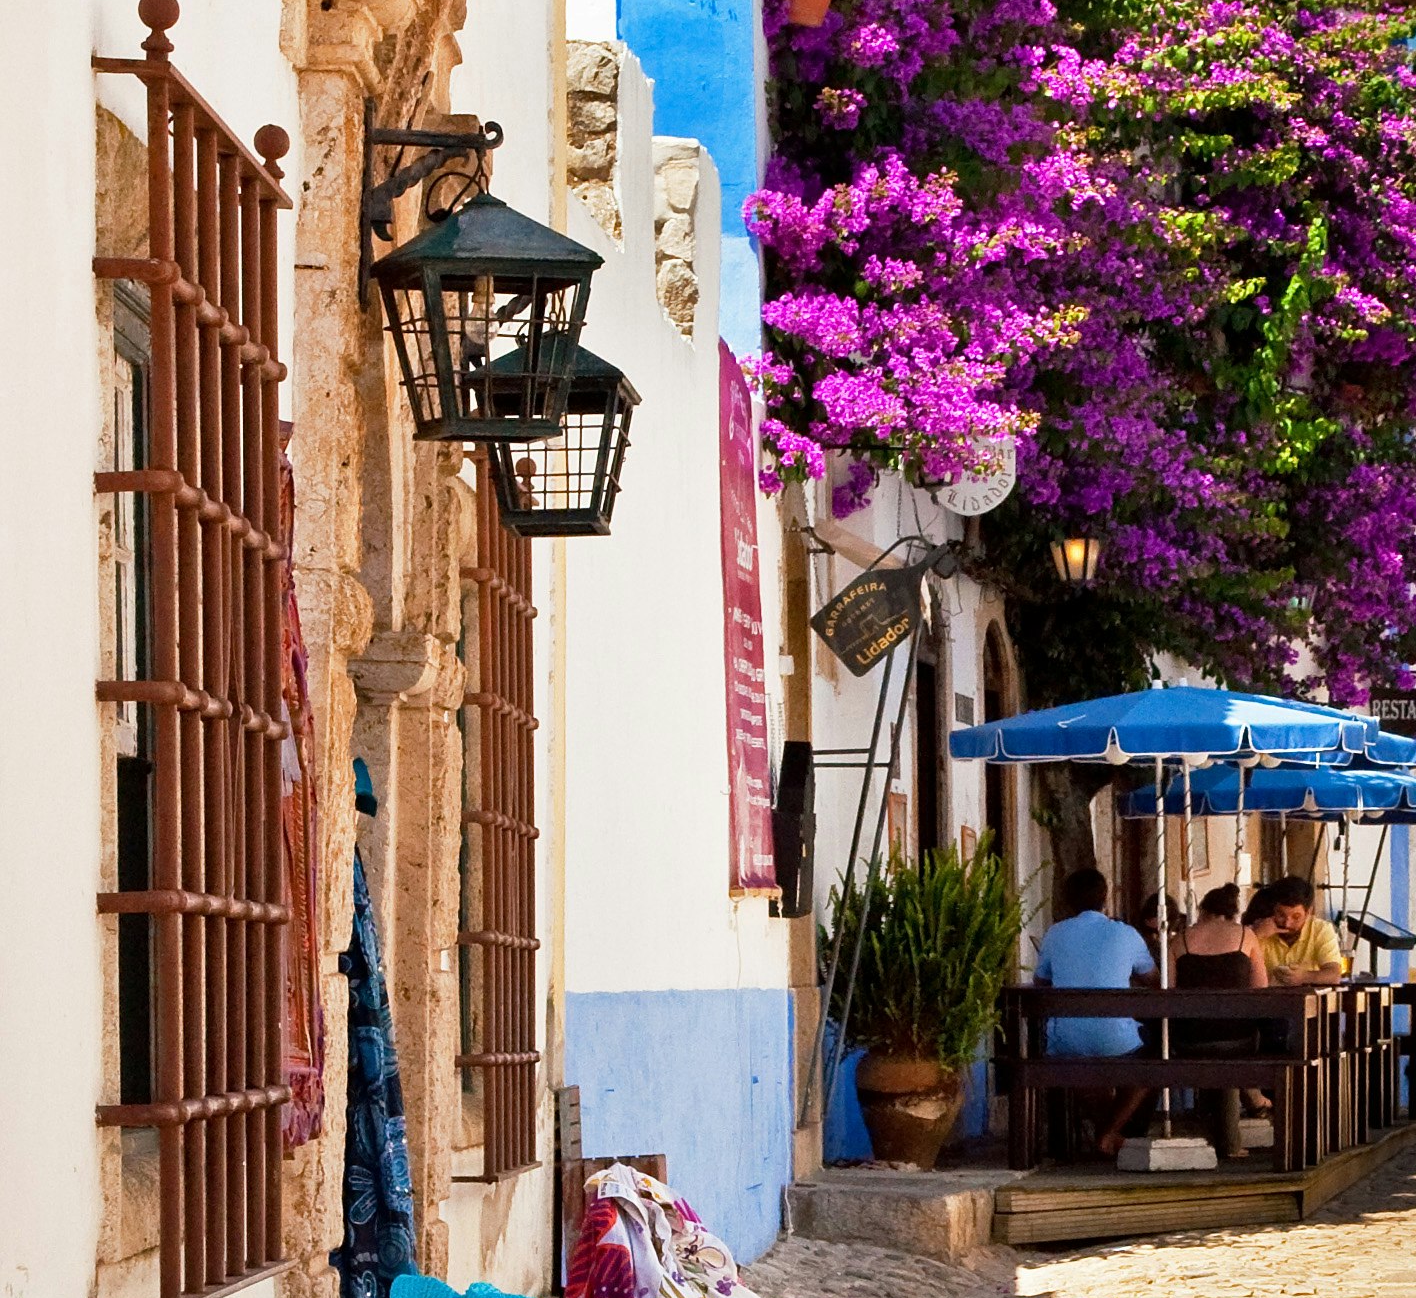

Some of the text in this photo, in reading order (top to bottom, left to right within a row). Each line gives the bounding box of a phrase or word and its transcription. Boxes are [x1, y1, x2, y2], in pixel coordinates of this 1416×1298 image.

[947, 472, 1012, 512] Lidador
[825, 582, 887, 636] GARRAFEIRA
[856, 617, 909, 665] Lidador
